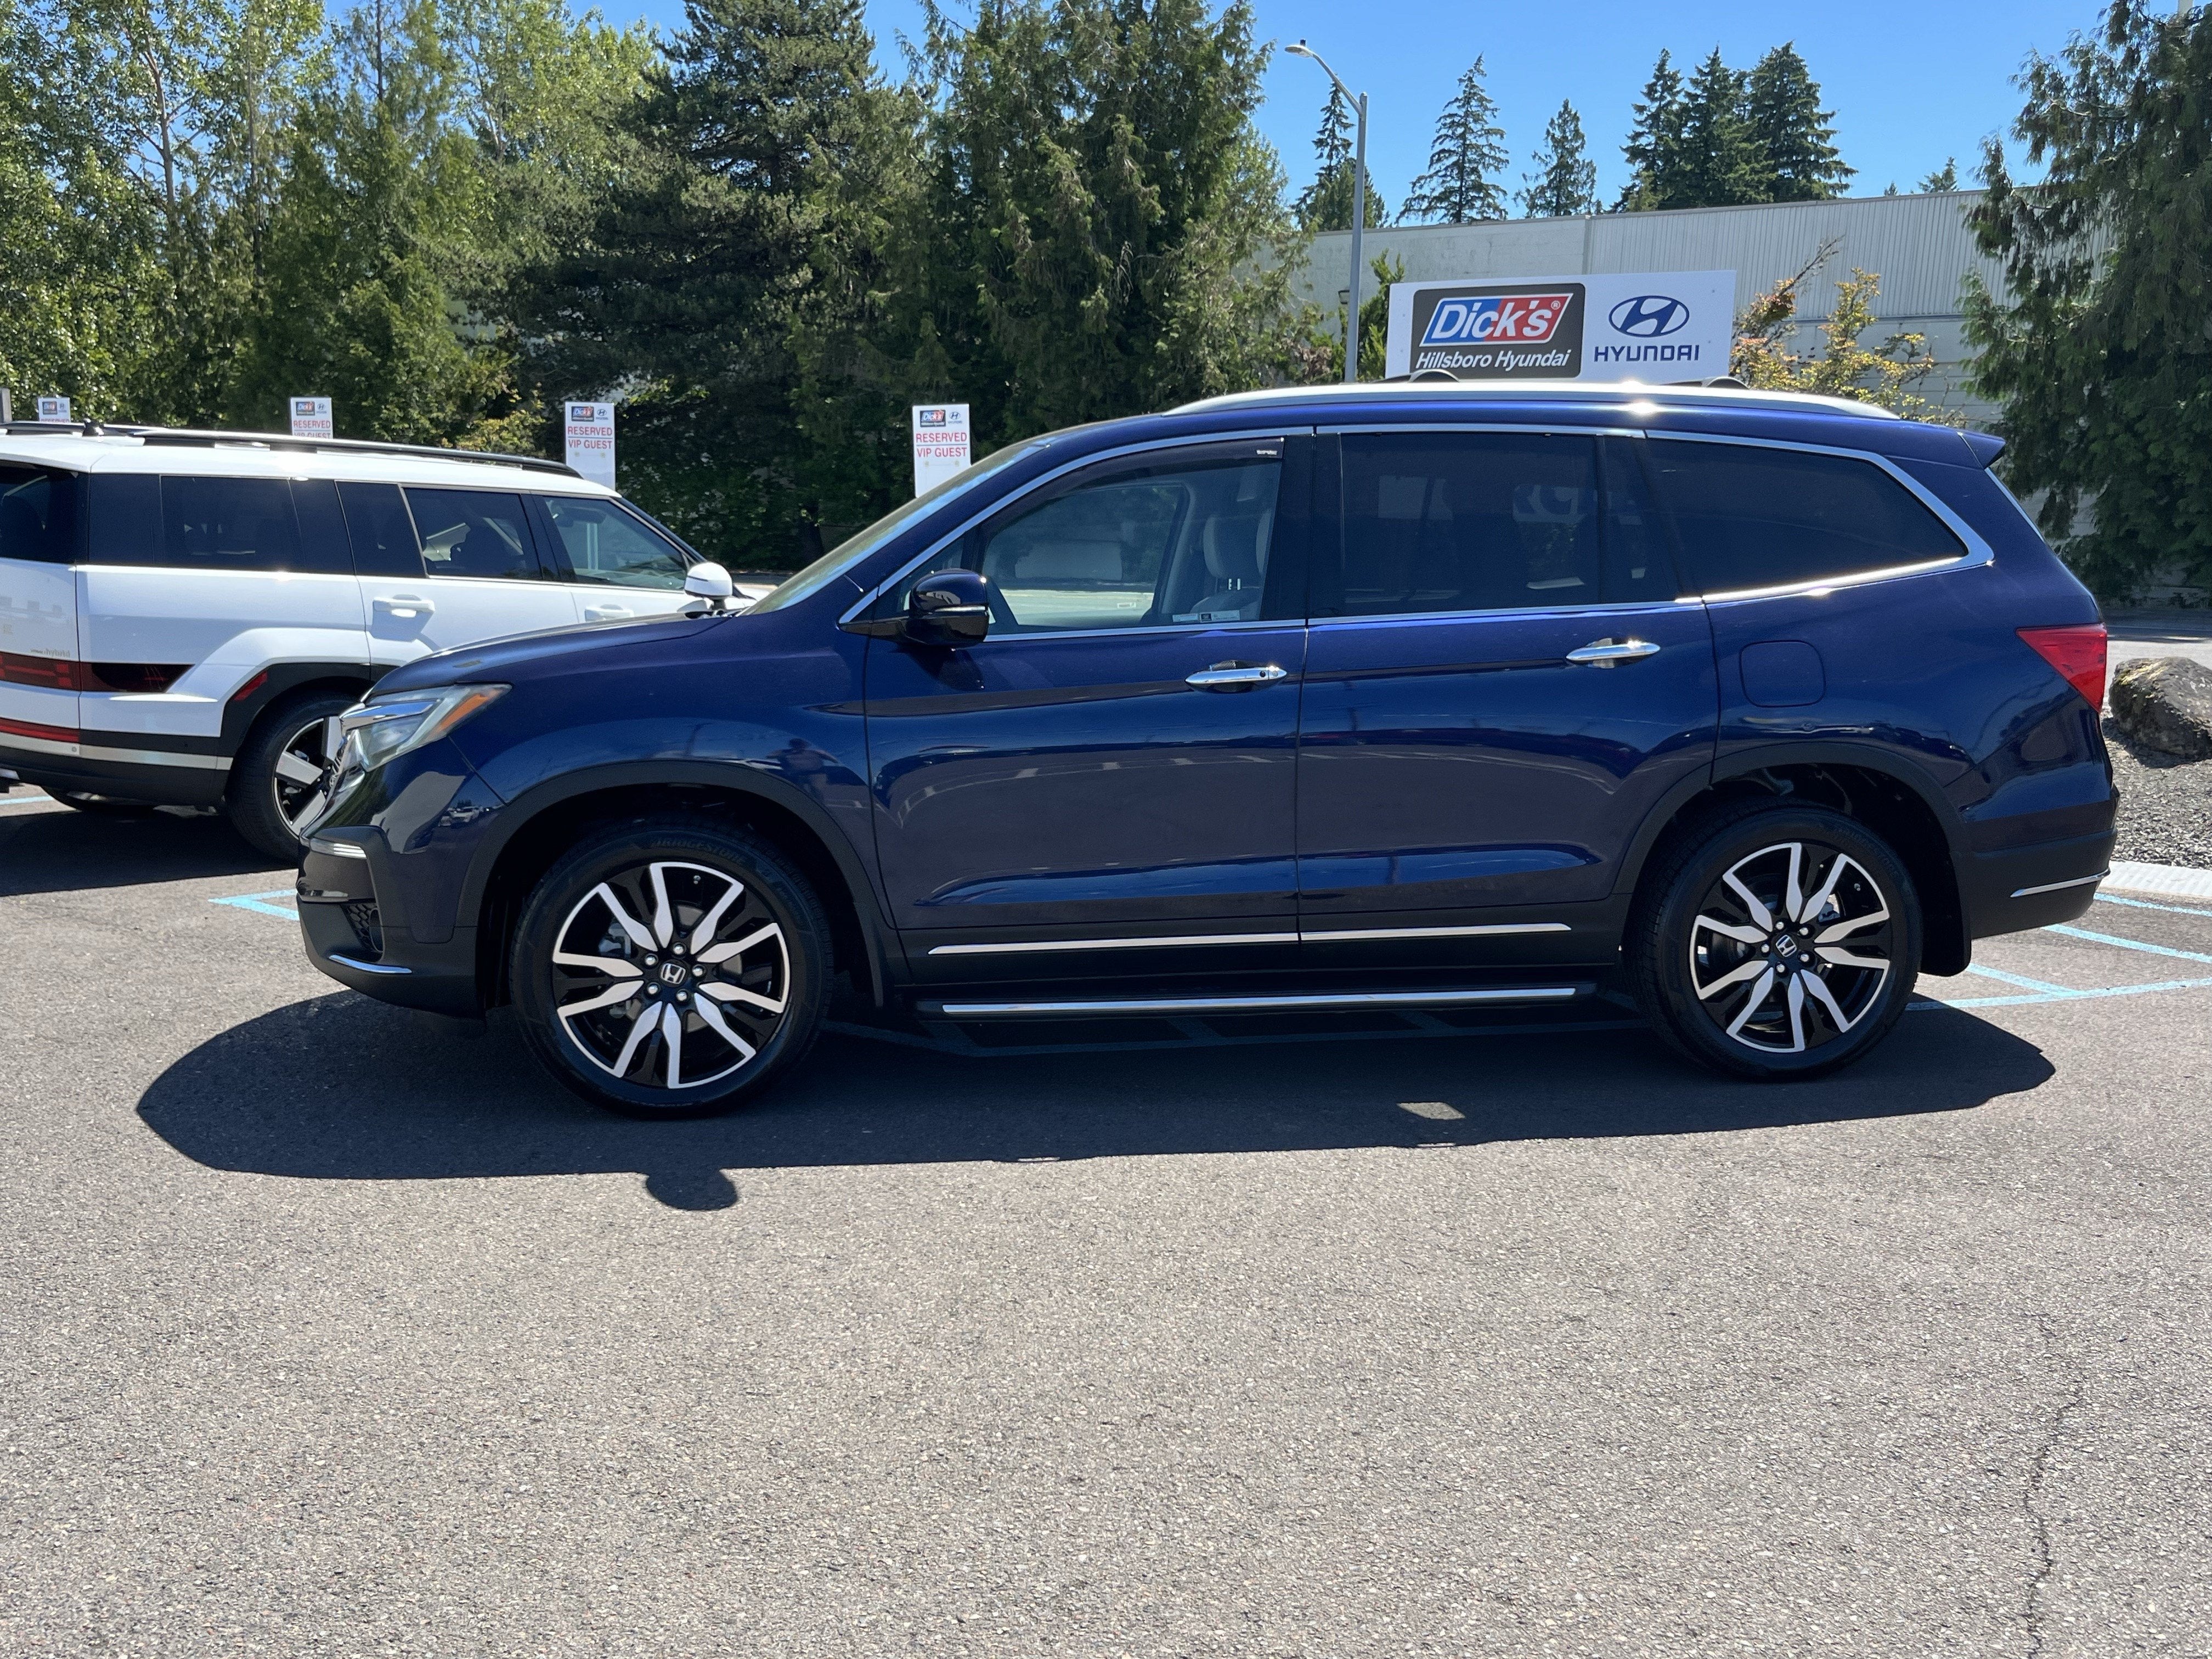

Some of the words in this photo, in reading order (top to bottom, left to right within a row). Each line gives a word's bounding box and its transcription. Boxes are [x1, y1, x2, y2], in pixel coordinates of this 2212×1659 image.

[1594, 345, 1700, 362] HYUNDAI
[1415, 351, 1493, 369] Hillsboro
[1494, 349, 1572, 372] Hyundai
[293, 420, 331, 428] RESERVED
[567, 426, 613, 436] RESERVED
[916, 432, 967, 443] RESERVED
[568, 439, 582, 448] VIP
[584, 439, 613, 449] GUEST
[916, 448, 932, 458] VIP
[934, 447, 967, 458] GUEST
